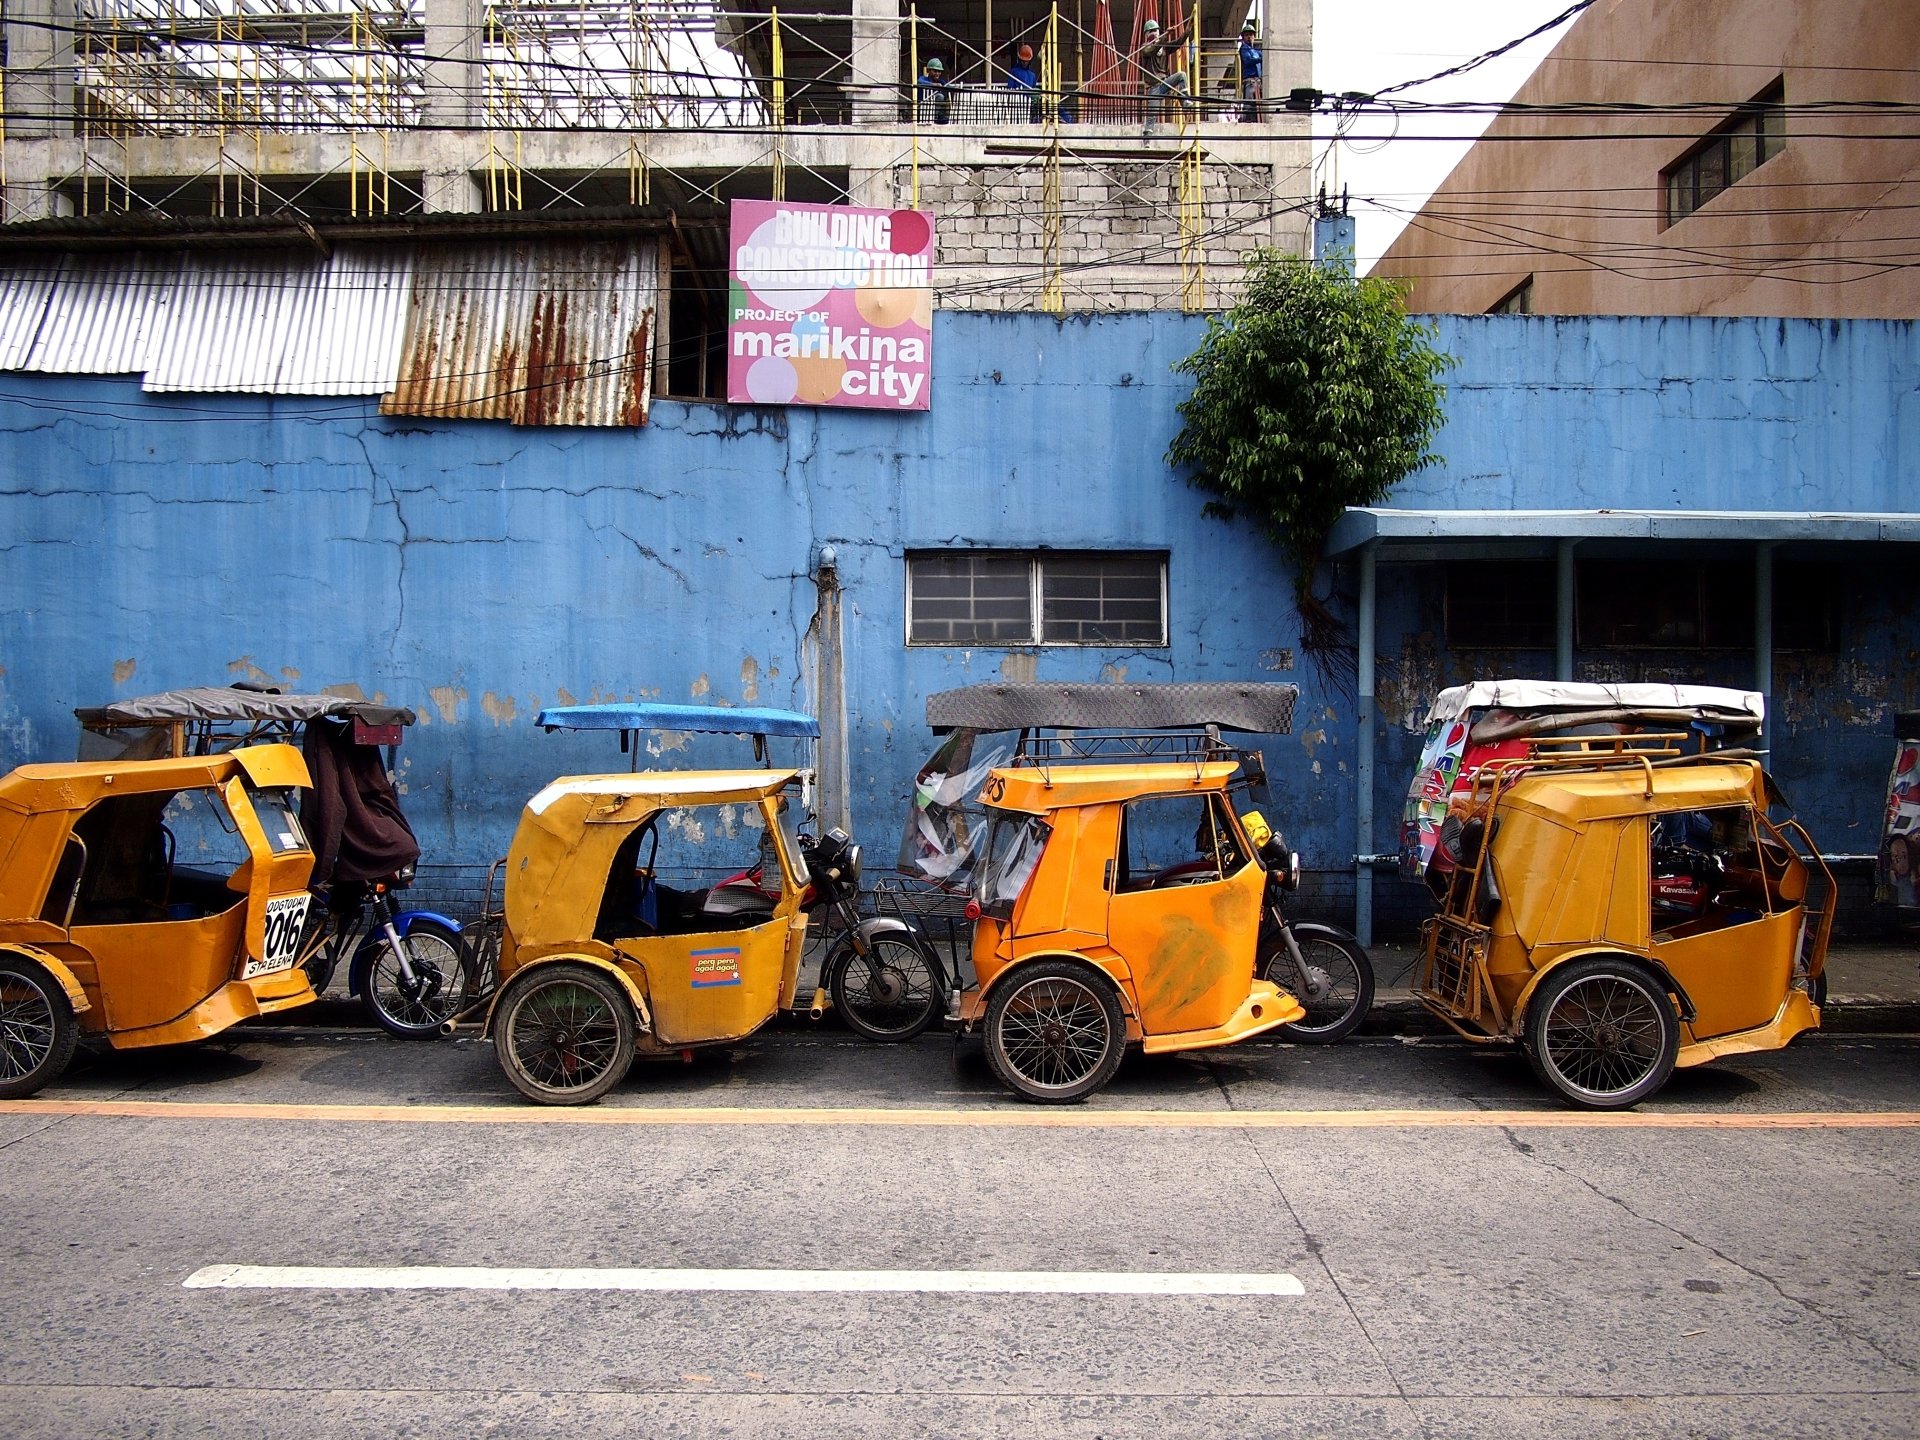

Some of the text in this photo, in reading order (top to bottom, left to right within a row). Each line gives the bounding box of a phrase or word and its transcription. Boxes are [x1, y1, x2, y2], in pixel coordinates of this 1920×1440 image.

[775, 209, 892, 250] BUILDING
[736, 245, 928, 287] CONSTRUCTION
[734, 308, 830, 323] PROJECT OF
[733, 327, 925, 362] marikina
[841, 363, 925, 406] city
[1660, 885, 1699, 895] Kawasaki
[695, 963, 738, 974] agad agad!
